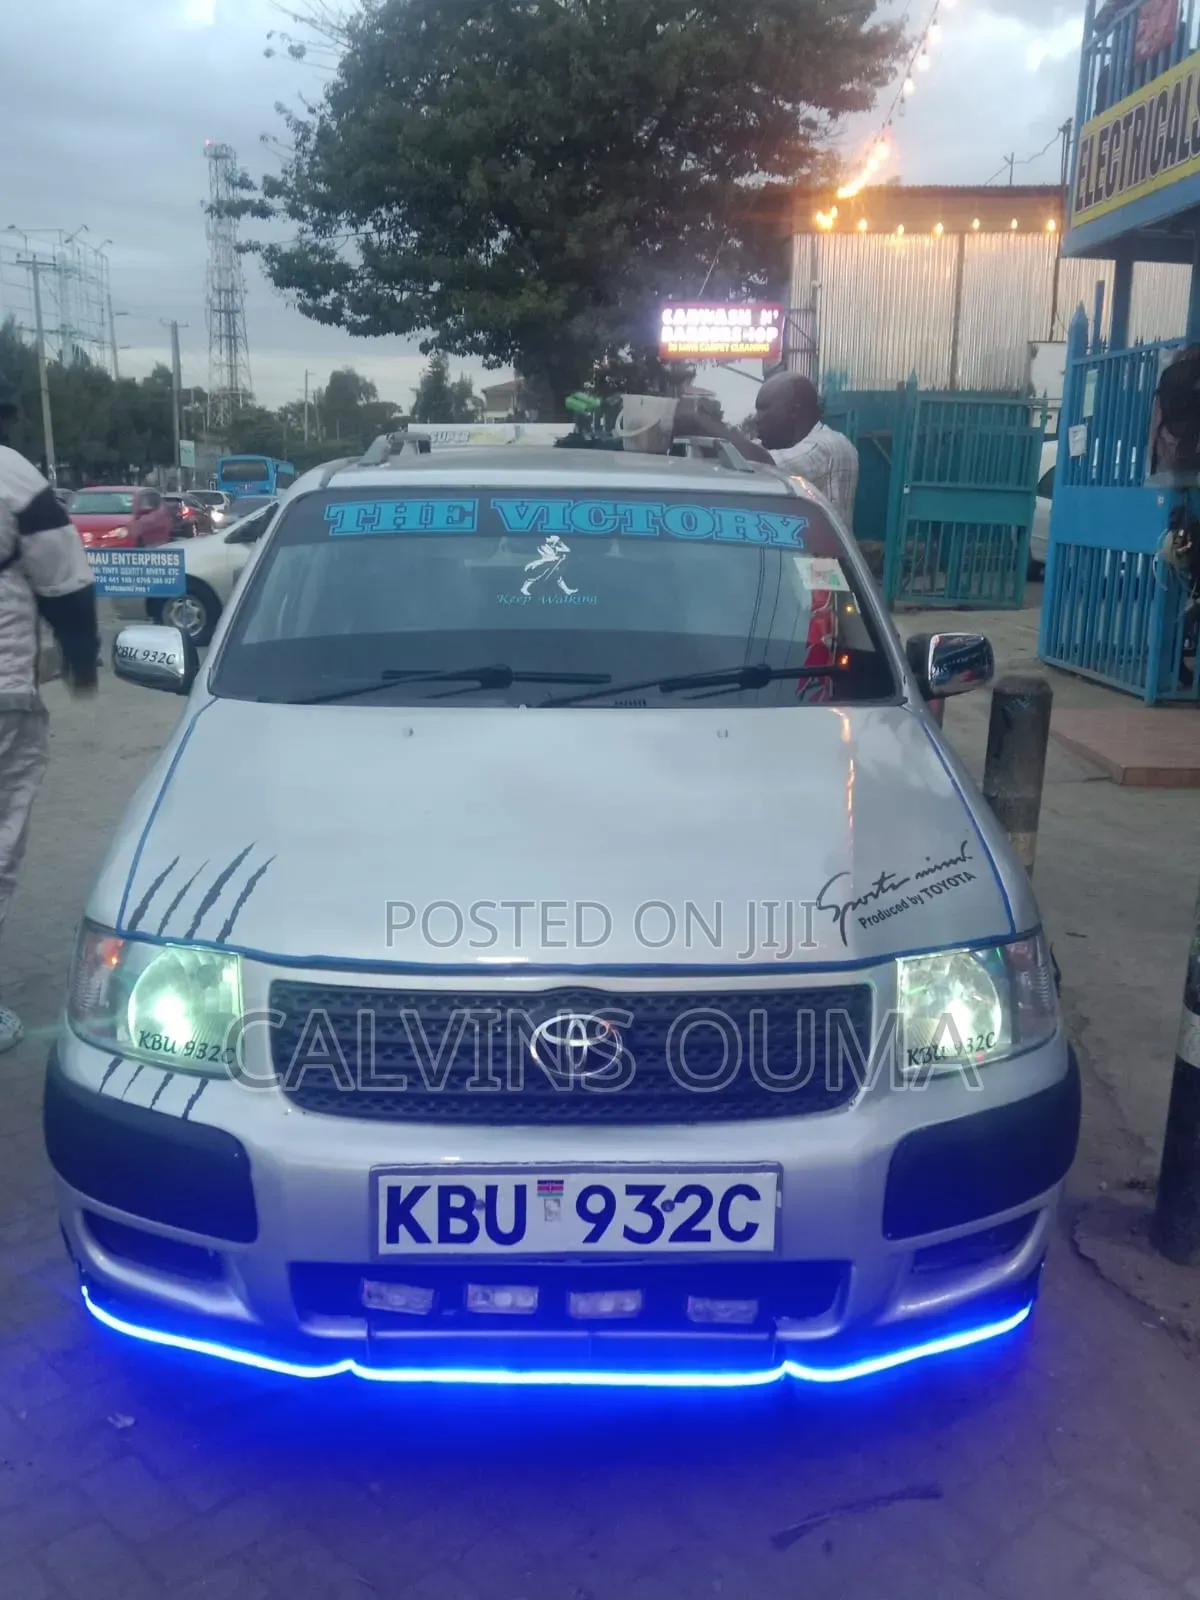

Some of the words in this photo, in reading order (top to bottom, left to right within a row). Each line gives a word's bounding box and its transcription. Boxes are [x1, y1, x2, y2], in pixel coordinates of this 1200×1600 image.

[324, 498, 479, 536] THE
[490, 498, 809, 549] VICTORY
[87, 552, 109, 564] MAU
[112, 553, 180, 566] ENTERPRISES
[142, 650, 176, 665] 932C
[858, 896, 909, 929] Produced
[908, 893, 925, 907] by
[919, 871, 977, 899] TOYOTA
[138, 1030, 177, 1054] KBU
[386, 1184, 527, 1246] KBU
[575, 1183, 761, 1244] 932C
